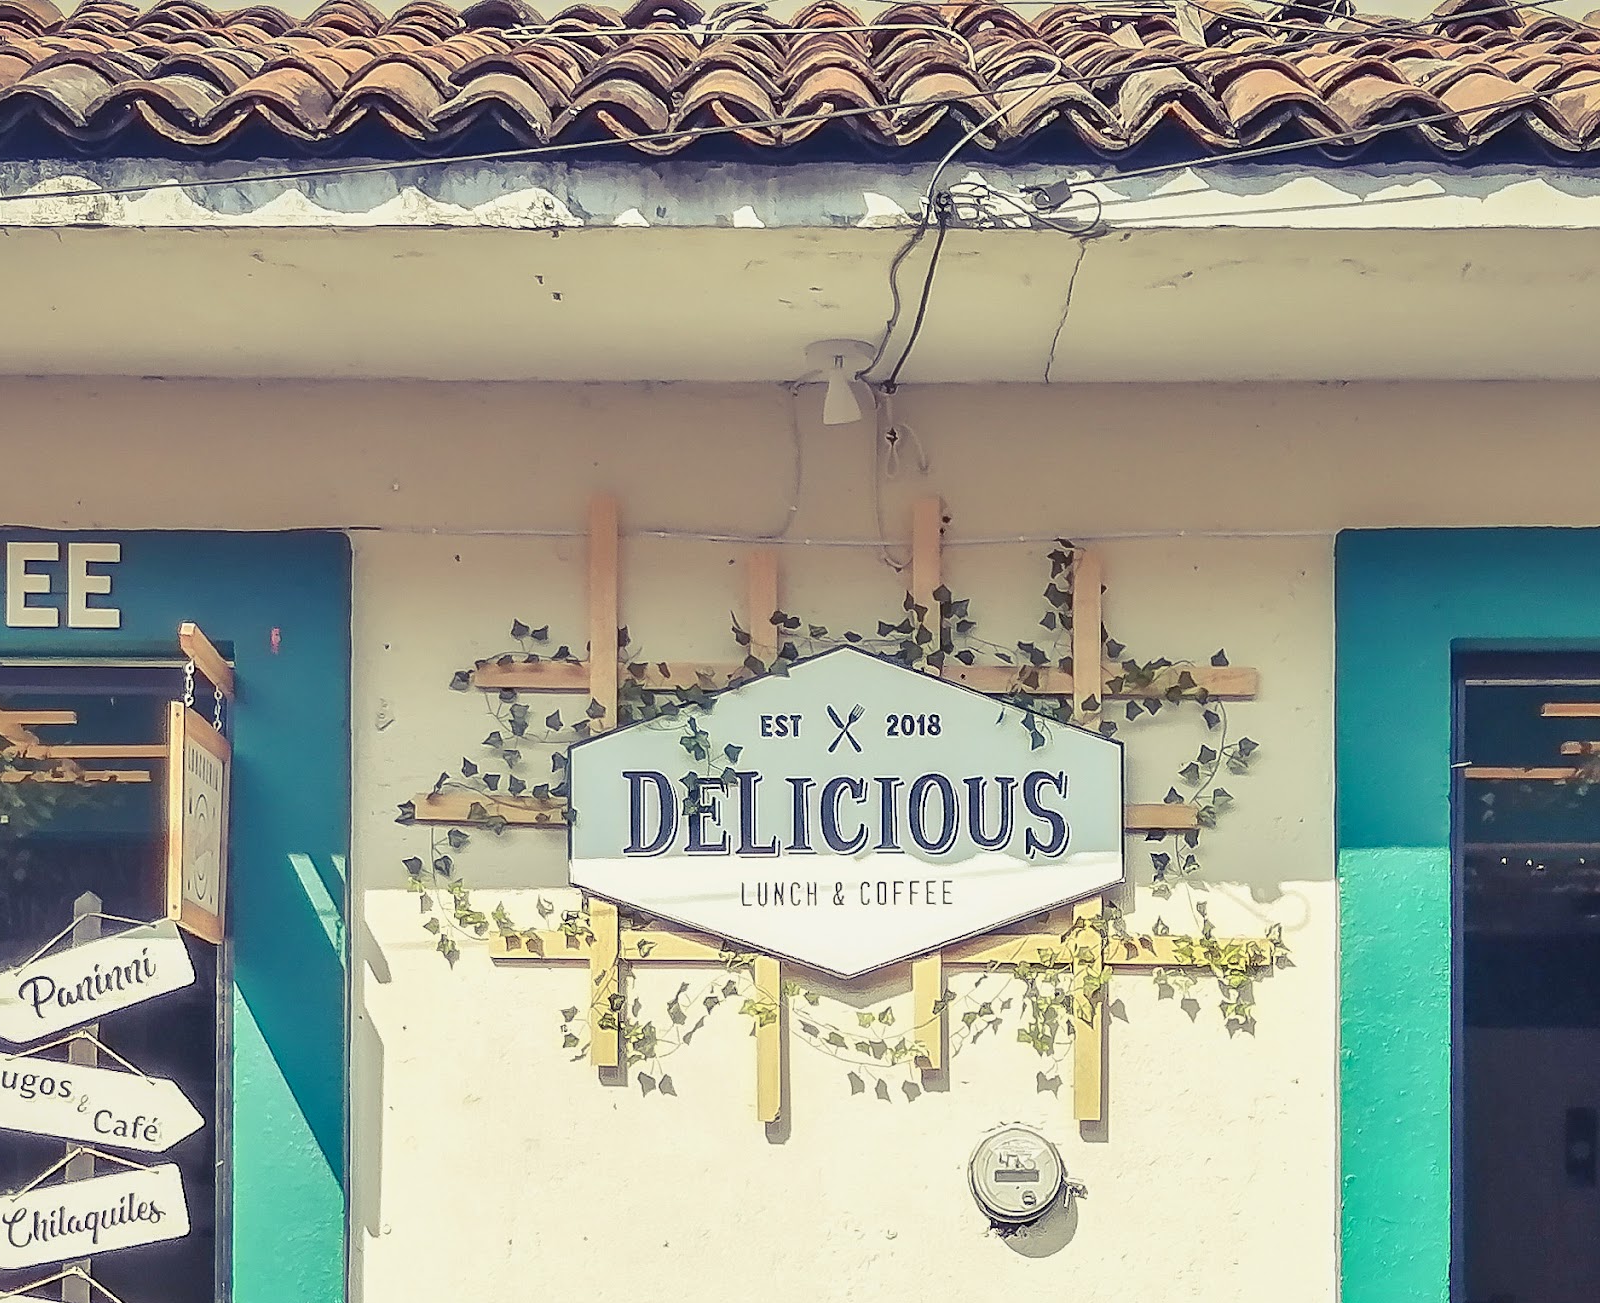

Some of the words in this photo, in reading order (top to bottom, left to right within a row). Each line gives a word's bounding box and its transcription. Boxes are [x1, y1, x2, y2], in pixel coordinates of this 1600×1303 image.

[760, 713, 802, 738] EST
[886, 713, 942, 738] 2018
[621, 767, 1071, 858] DELICIOUS
[741, 880, 818, 907] LUNCH
[832, 880, 845, 906] &
[860, 880, 954, 906] COFFEE
[18, 947, 156, 1019] Paninni
[93, 1109, 159, 1143] Café
[2, 1193, 167, 1248] Chilaquiles
